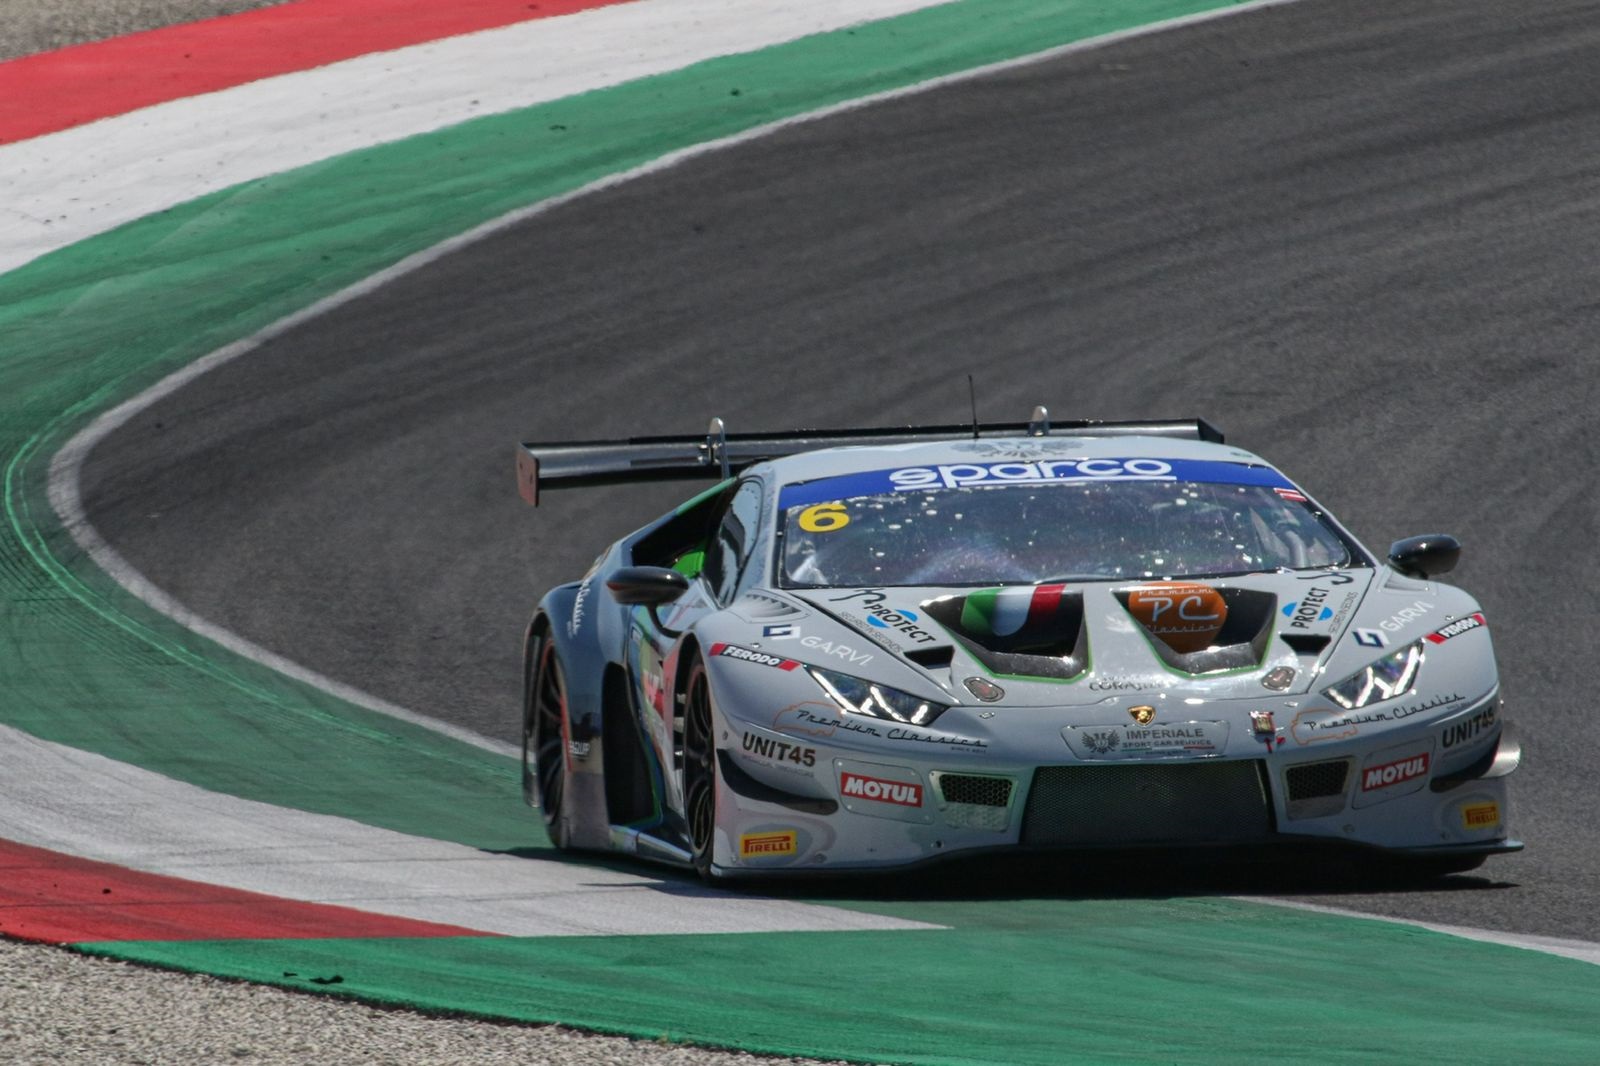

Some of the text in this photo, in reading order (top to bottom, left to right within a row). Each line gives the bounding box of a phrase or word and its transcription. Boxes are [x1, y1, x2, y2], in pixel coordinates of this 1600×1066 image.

[889, 459, 1174, 489] sparco
[798, 503, 850, 532] 6
[863, 603, 936, 643] PROTECT
[1138, 596, 1219, 622] PC
[1290, 587, 1330, 629] PROTECT
[1379, 600, 1435, 632] GARVI
[723, 646, 781, 667] FERODO
[800, 636, 874, 666] GARVI
[1304, 713, 1394, 731] Premium
[1392, 693, 1466, 719] Classics
[797, 709, 989, 748] Premium Classics
[1126, 728, 1204, 739] IMPERIALE
[1442, 707, 1495, 748] UNIT45
[742, 731, 816, 767] UNIT45
[1365, 758, 1425, 788] MOTUL
[844, 776, 918, 803] MOTUL
[1466, 806, 1497, 825] PIRELLI
[744, 835, 792, 854] PIRELLI
